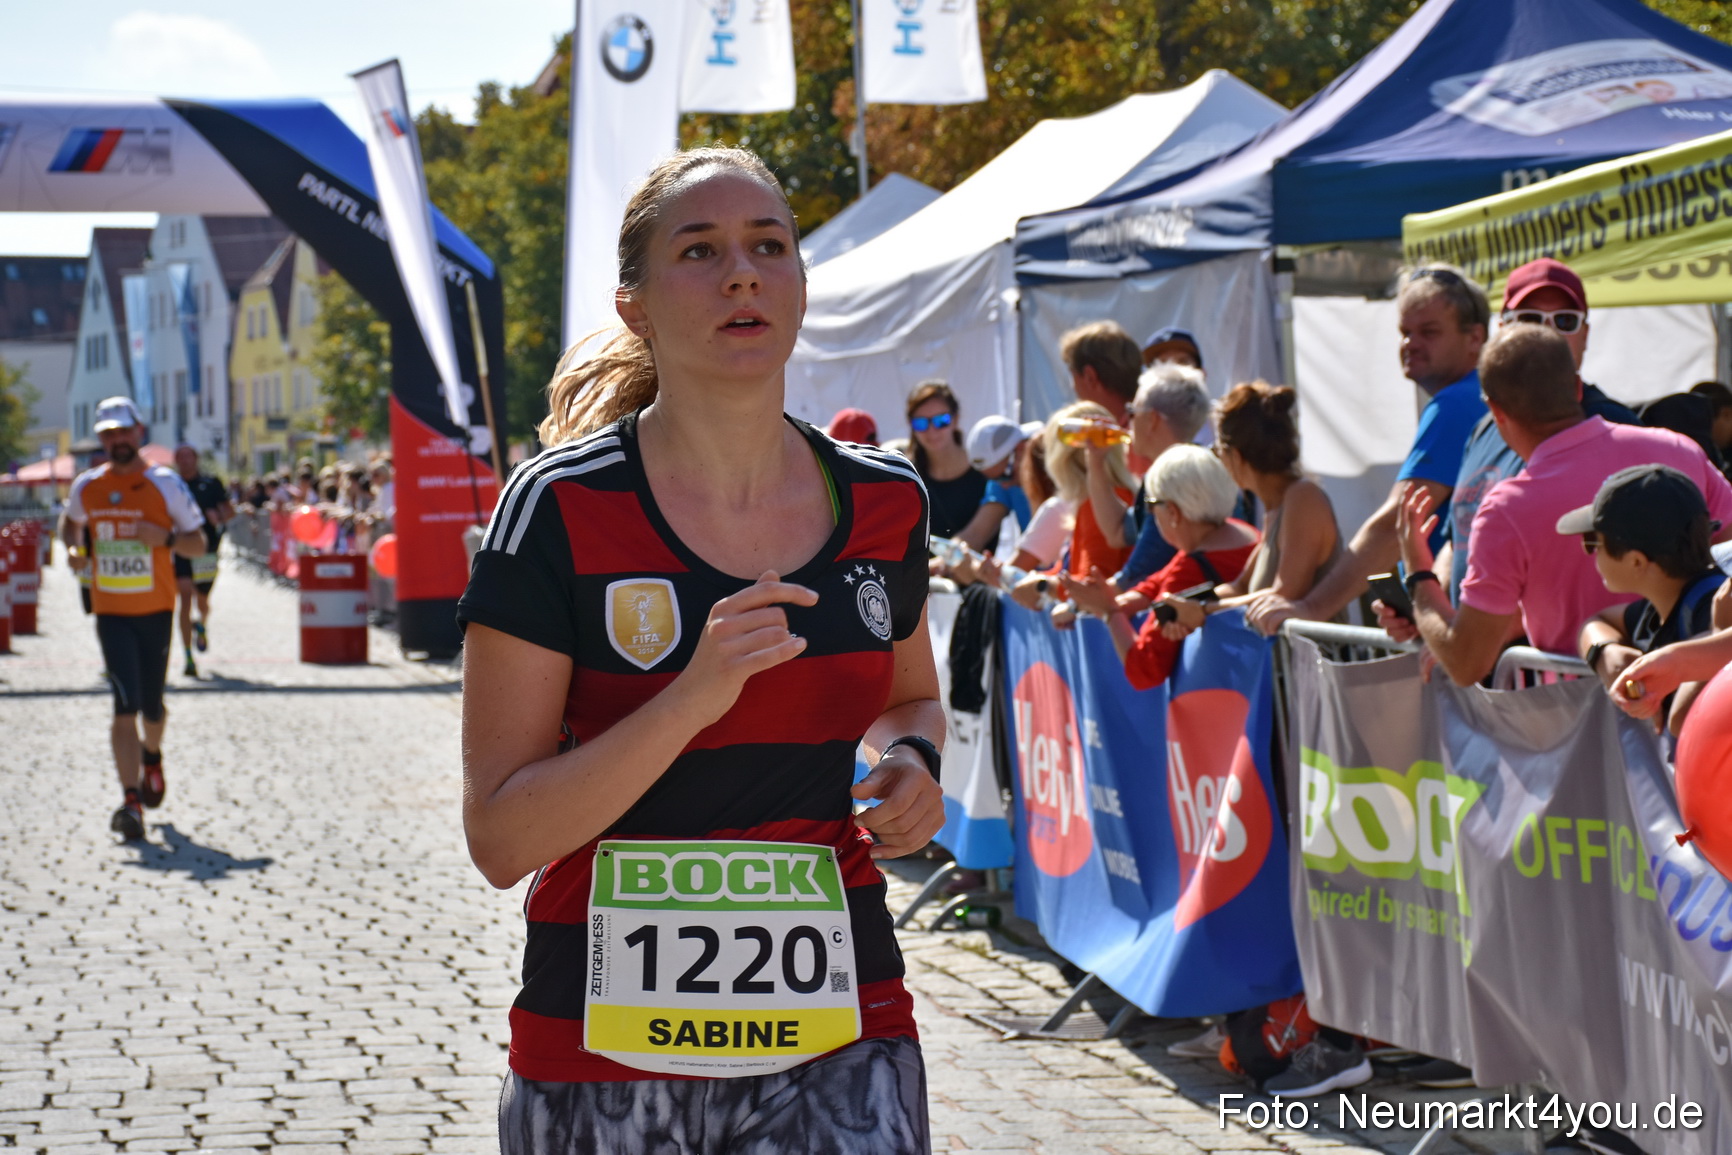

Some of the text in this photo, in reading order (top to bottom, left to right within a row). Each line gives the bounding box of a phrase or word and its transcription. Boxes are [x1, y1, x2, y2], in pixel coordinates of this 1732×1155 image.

[298, 172, 361, 224] PARTL
[632, 633, 660, 644] FIFA
[613, 851, 829, 902] BOCK
[833, 931, 843, 943] C
[624, 924, 828, 994] 1220
[647, 1018, 799, 1048] SABINE
